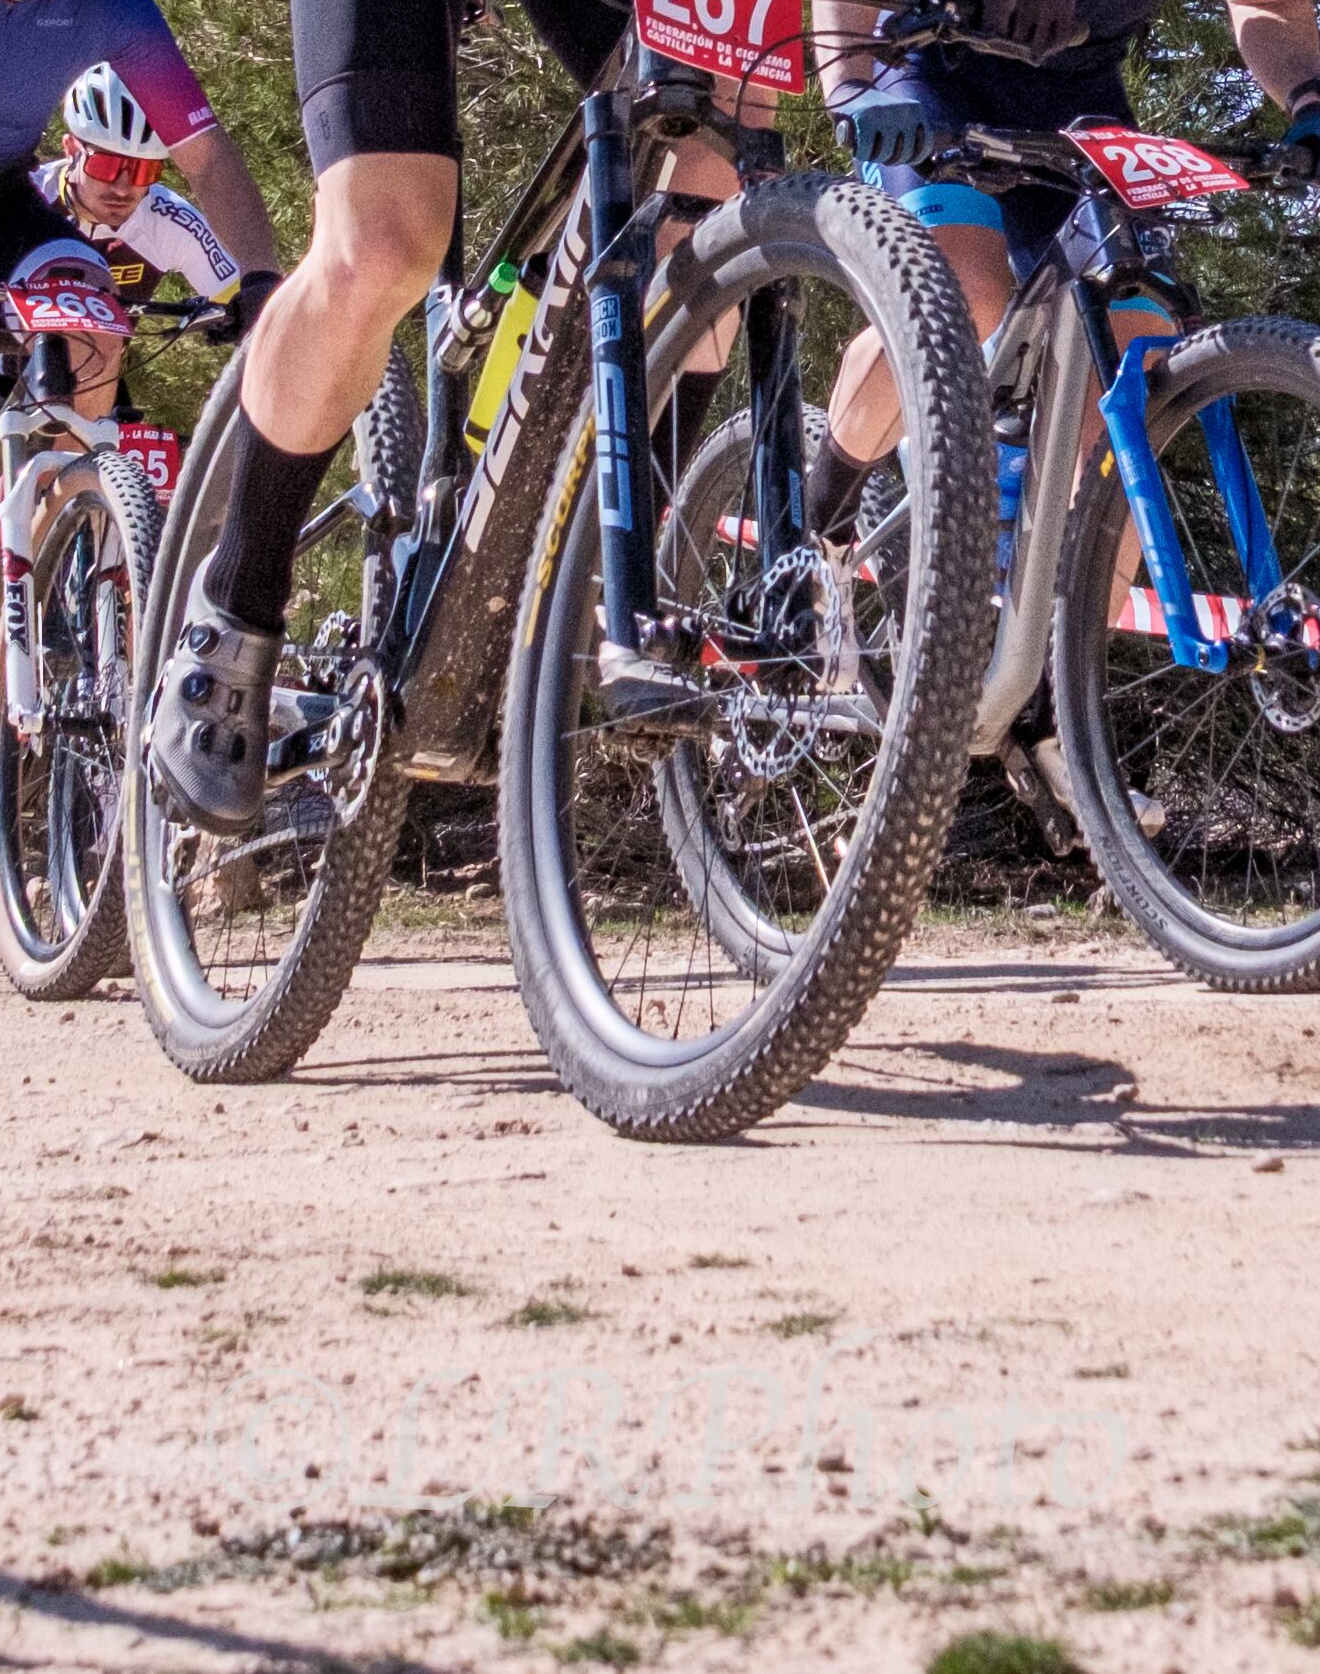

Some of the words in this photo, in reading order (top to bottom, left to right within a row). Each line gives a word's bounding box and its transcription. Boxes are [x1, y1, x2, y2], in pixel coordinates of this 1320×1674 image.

[646, 16, 713, 50] FEDERACIÓN
[716, 41, 732, 55] DE
[735, 47, 792, 69] CICSMO
[646, 28, 694, 56] CASTILLA
[718, 54, 733, 68] LA
[1103, 143, 1213, 183] 268
[25, 292, 115, 322] 266
[128, 449, 169, 487] 65
